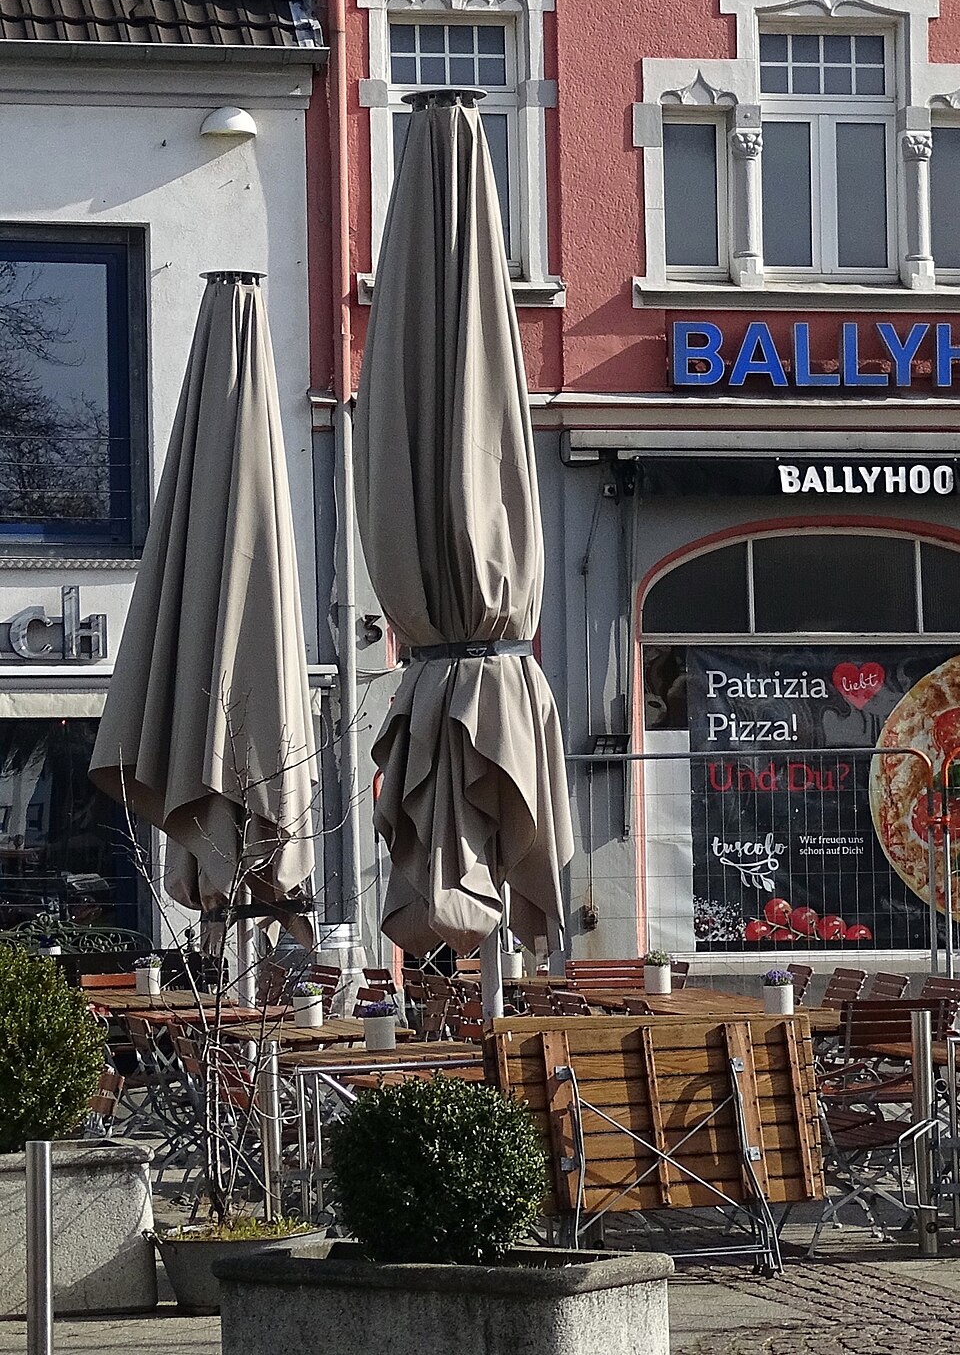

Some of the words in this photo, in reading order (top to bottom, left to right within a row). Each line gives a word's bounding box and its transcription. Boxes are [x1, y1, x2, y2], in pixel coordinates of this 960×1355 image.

[778, 465, 954, 494] BALLYHOO
[705, 670, 829, 698] Patrizia
[841, 672, 878, 692] liebt
[706, 713, 799, 741] Pizza!
[708, 761, 778, 792] Und
[787, 761, 850, 792] Du?
[711, 832, 788, 857] tuscolo
[799, 835, 817, 844] Wir
[818, 835, 847, 844] freuen
[848, 836, 864, 844] uns
[799, 846, 825, 855] schon
[826, 846, 841, 855] auf
[842, 846, 864, 855] Dich!
